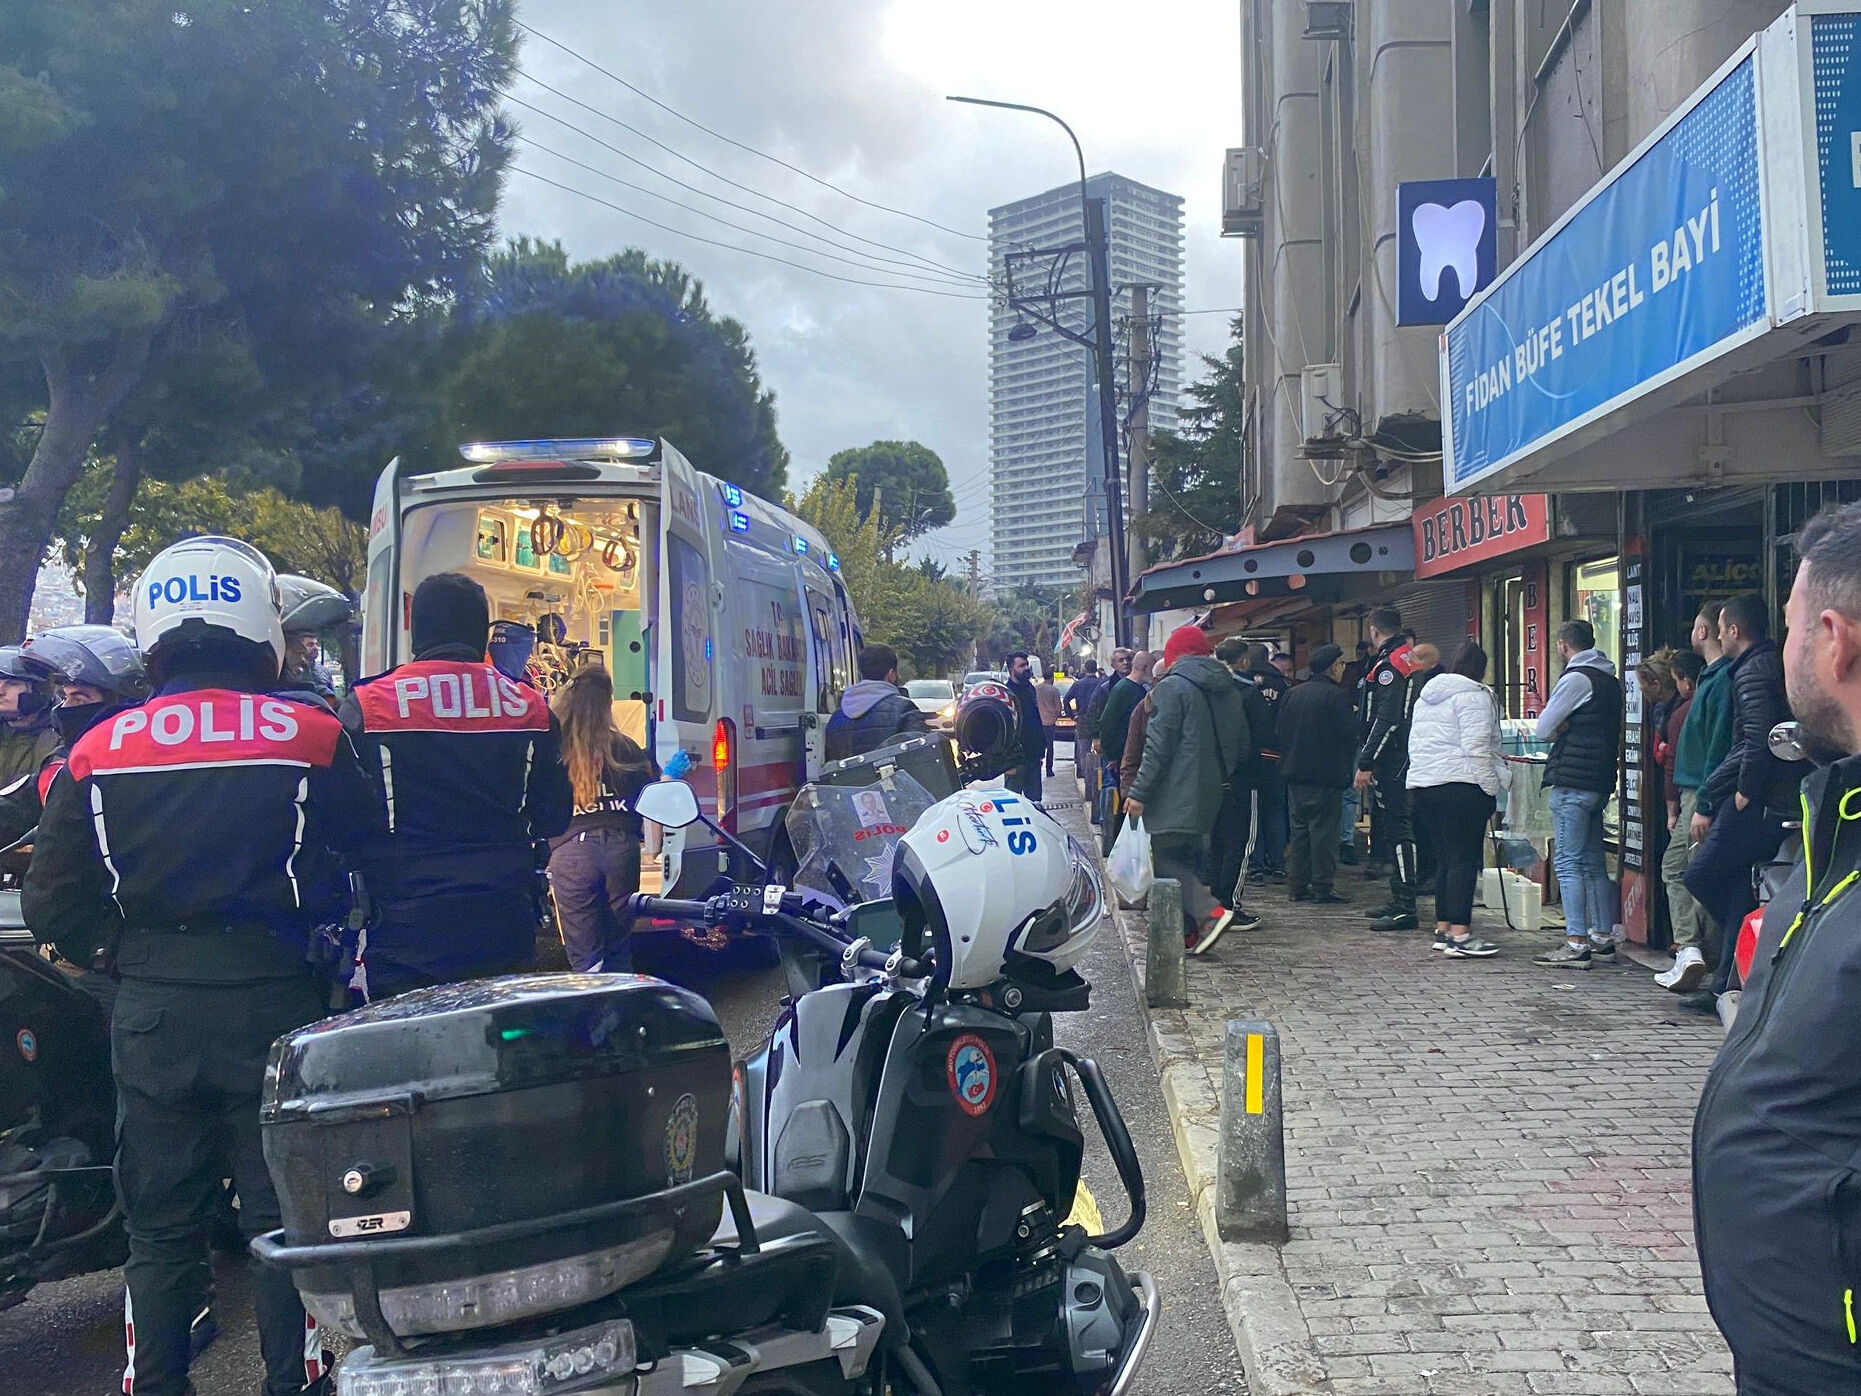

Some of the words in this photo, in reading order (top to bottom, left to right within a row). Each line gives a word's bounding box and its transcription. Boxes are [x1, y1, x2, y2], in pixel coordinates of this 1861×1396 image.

[1466, 354, 1511, 418] FİDAN
[1515, 316, 1563, 384] BÜFE
[1567, 262, 1644, 346] TEKEL
[1651, 186, 1720, 294] BAYİ
[1421, 495, 1528, 563] BERBER
[109, 695, 299, 751] POLİS
[395, 668, 528, 718] POLİS
